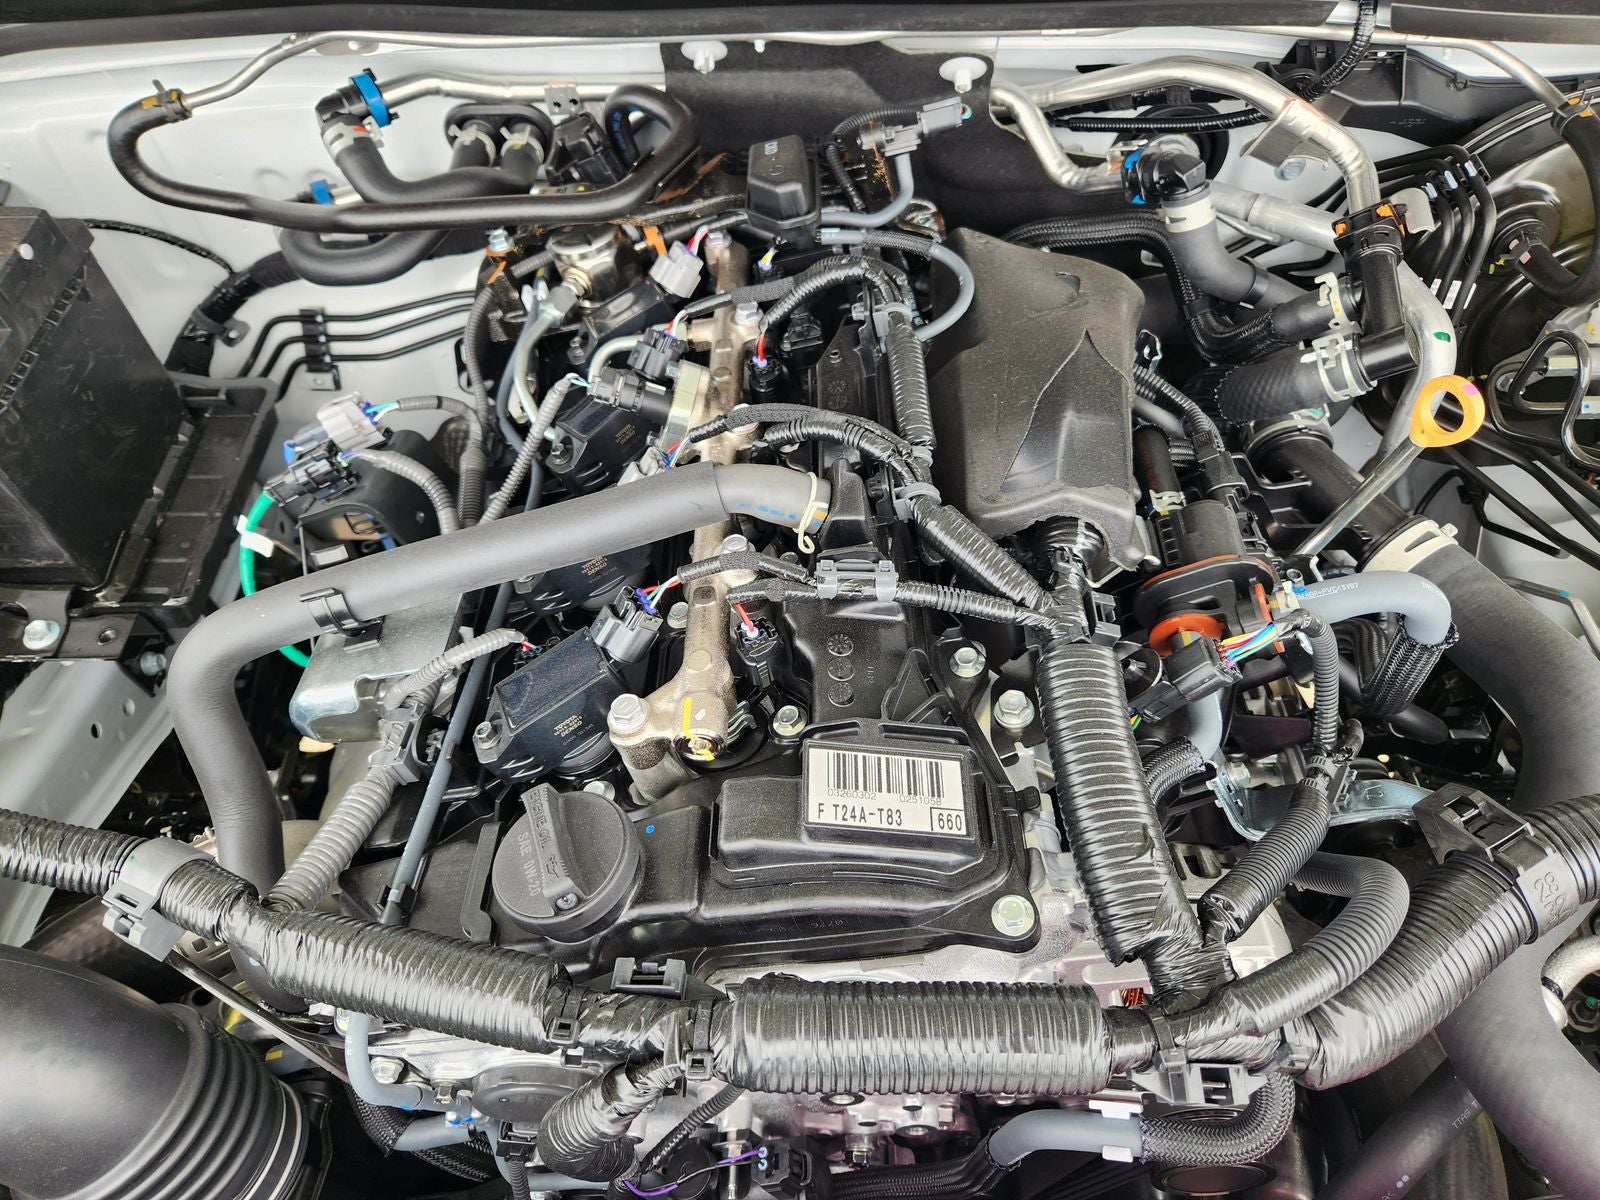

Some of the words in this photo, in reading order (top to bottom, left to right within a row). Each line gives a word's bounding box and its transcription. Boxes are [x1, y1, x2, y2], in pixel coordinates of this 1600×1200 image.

[554, 715, 580, 731] TOYOTA
[561, 720, 583, 737] DENSO
[827, 788, 877, 801] 03260302
[899, 794, 942, 806] 0251058
[818, 802, 825, 819] F
[832, 803, 903, 827] T24A-T83
[938, 812, 962, 831] 660
[517, 831, 532, 857] SAE
[523, 859, 541, 897] 0W-20
